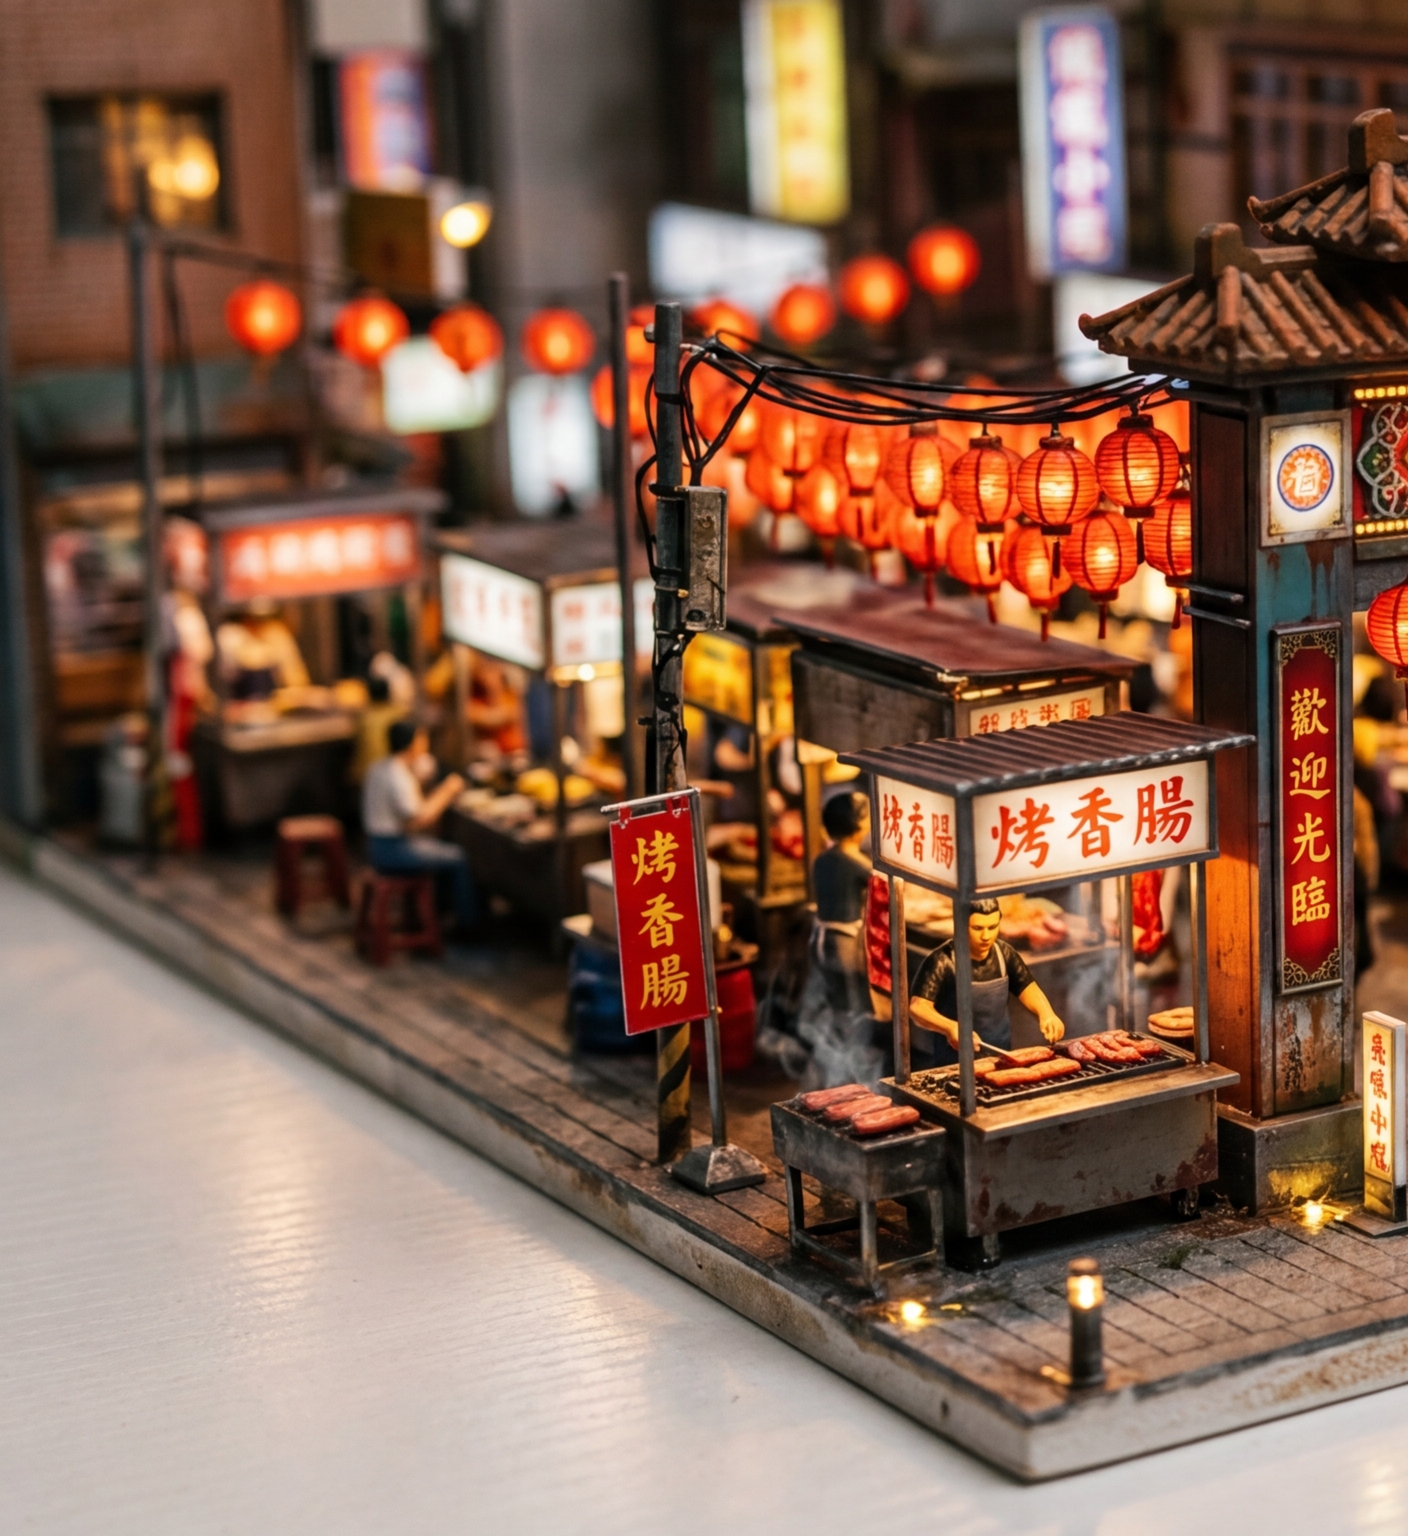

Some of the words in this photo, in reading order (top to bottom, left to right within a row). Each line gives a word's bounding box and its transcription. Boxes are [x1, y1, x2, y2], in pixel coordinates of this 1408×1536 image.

[882, 793, 954, 870] 烤香腸
[990, 775, 1195, 870] 烤香腸
[1289, 687, 1331, 926] 歡迎光臨
[631, 830, 690, 1010] 烤香腸
